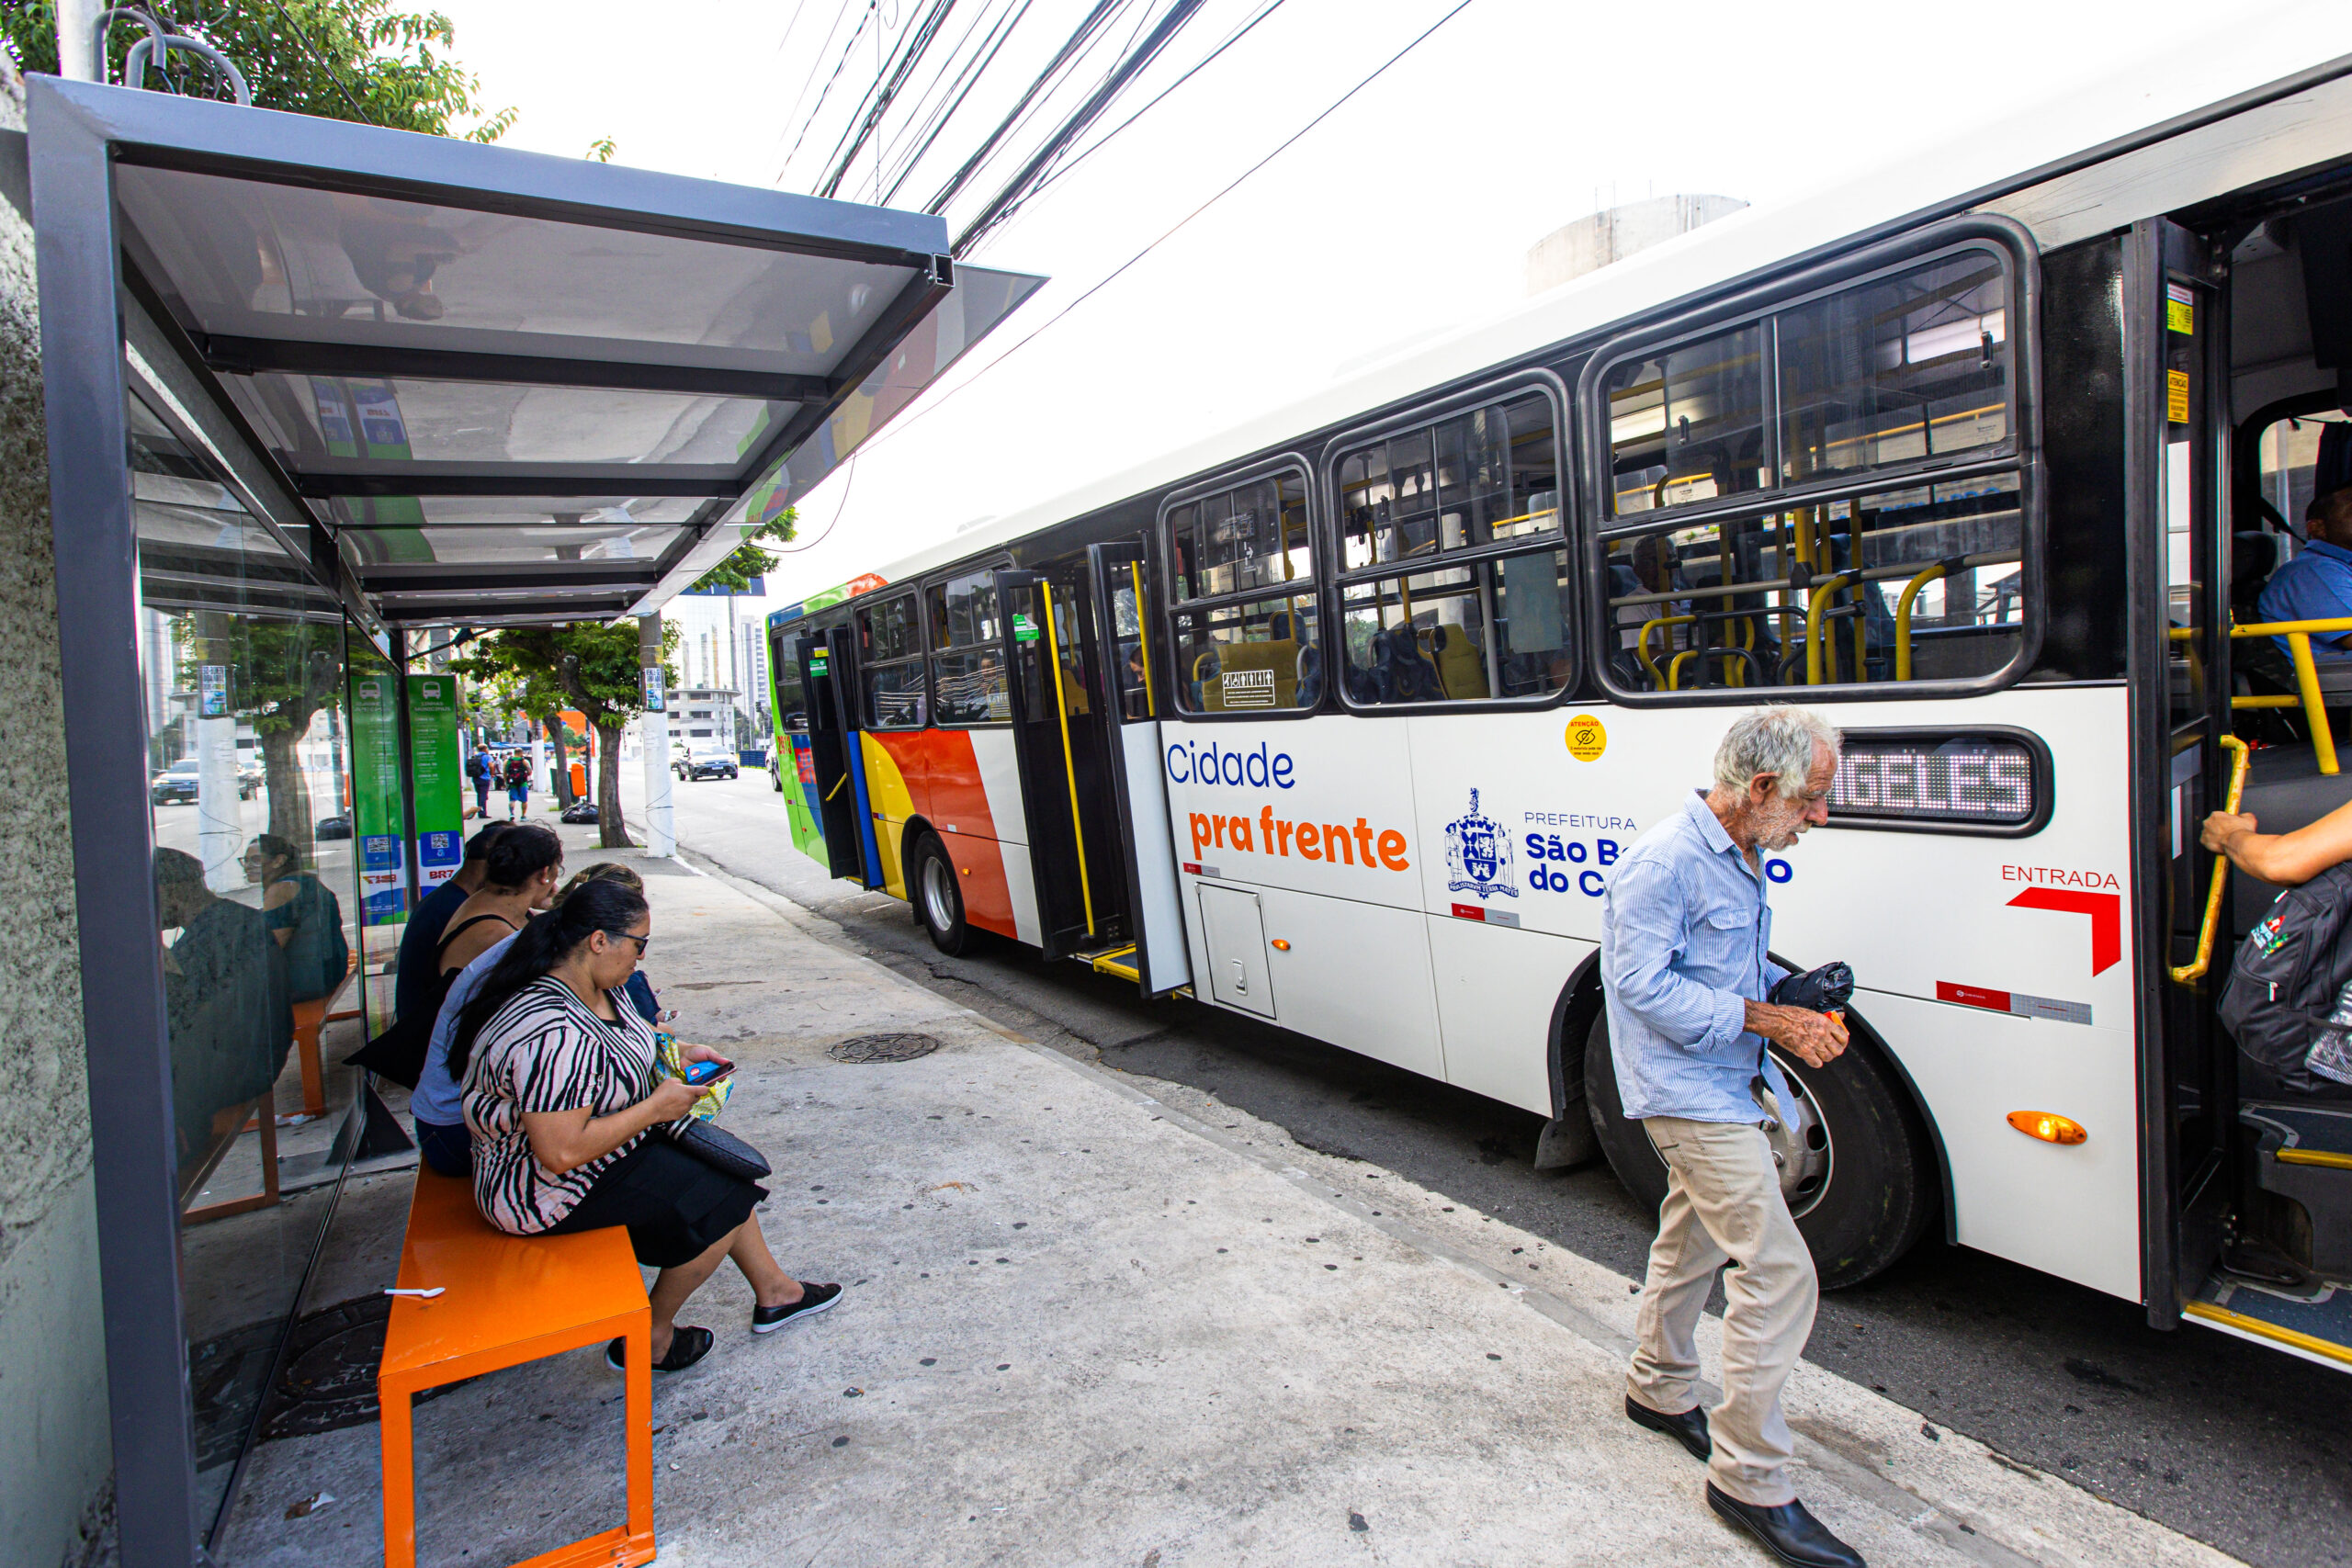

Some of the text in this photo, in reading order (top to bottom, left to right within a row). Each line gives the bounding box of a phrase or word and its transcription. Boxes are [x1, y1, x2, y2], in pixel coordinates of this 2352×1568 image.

[777, 735, 792, 755] 2913
[1167, 740, 1295, 789] Cidade
[1524, 812, 1636, 831] PREFEITURA
[1189, 805, 1410, 872] pra frente
[1525, 833, 1588, 864] São
[1529, 863, 1569, 894] do
[2002, 864, 2120, 890] ENTRADA
